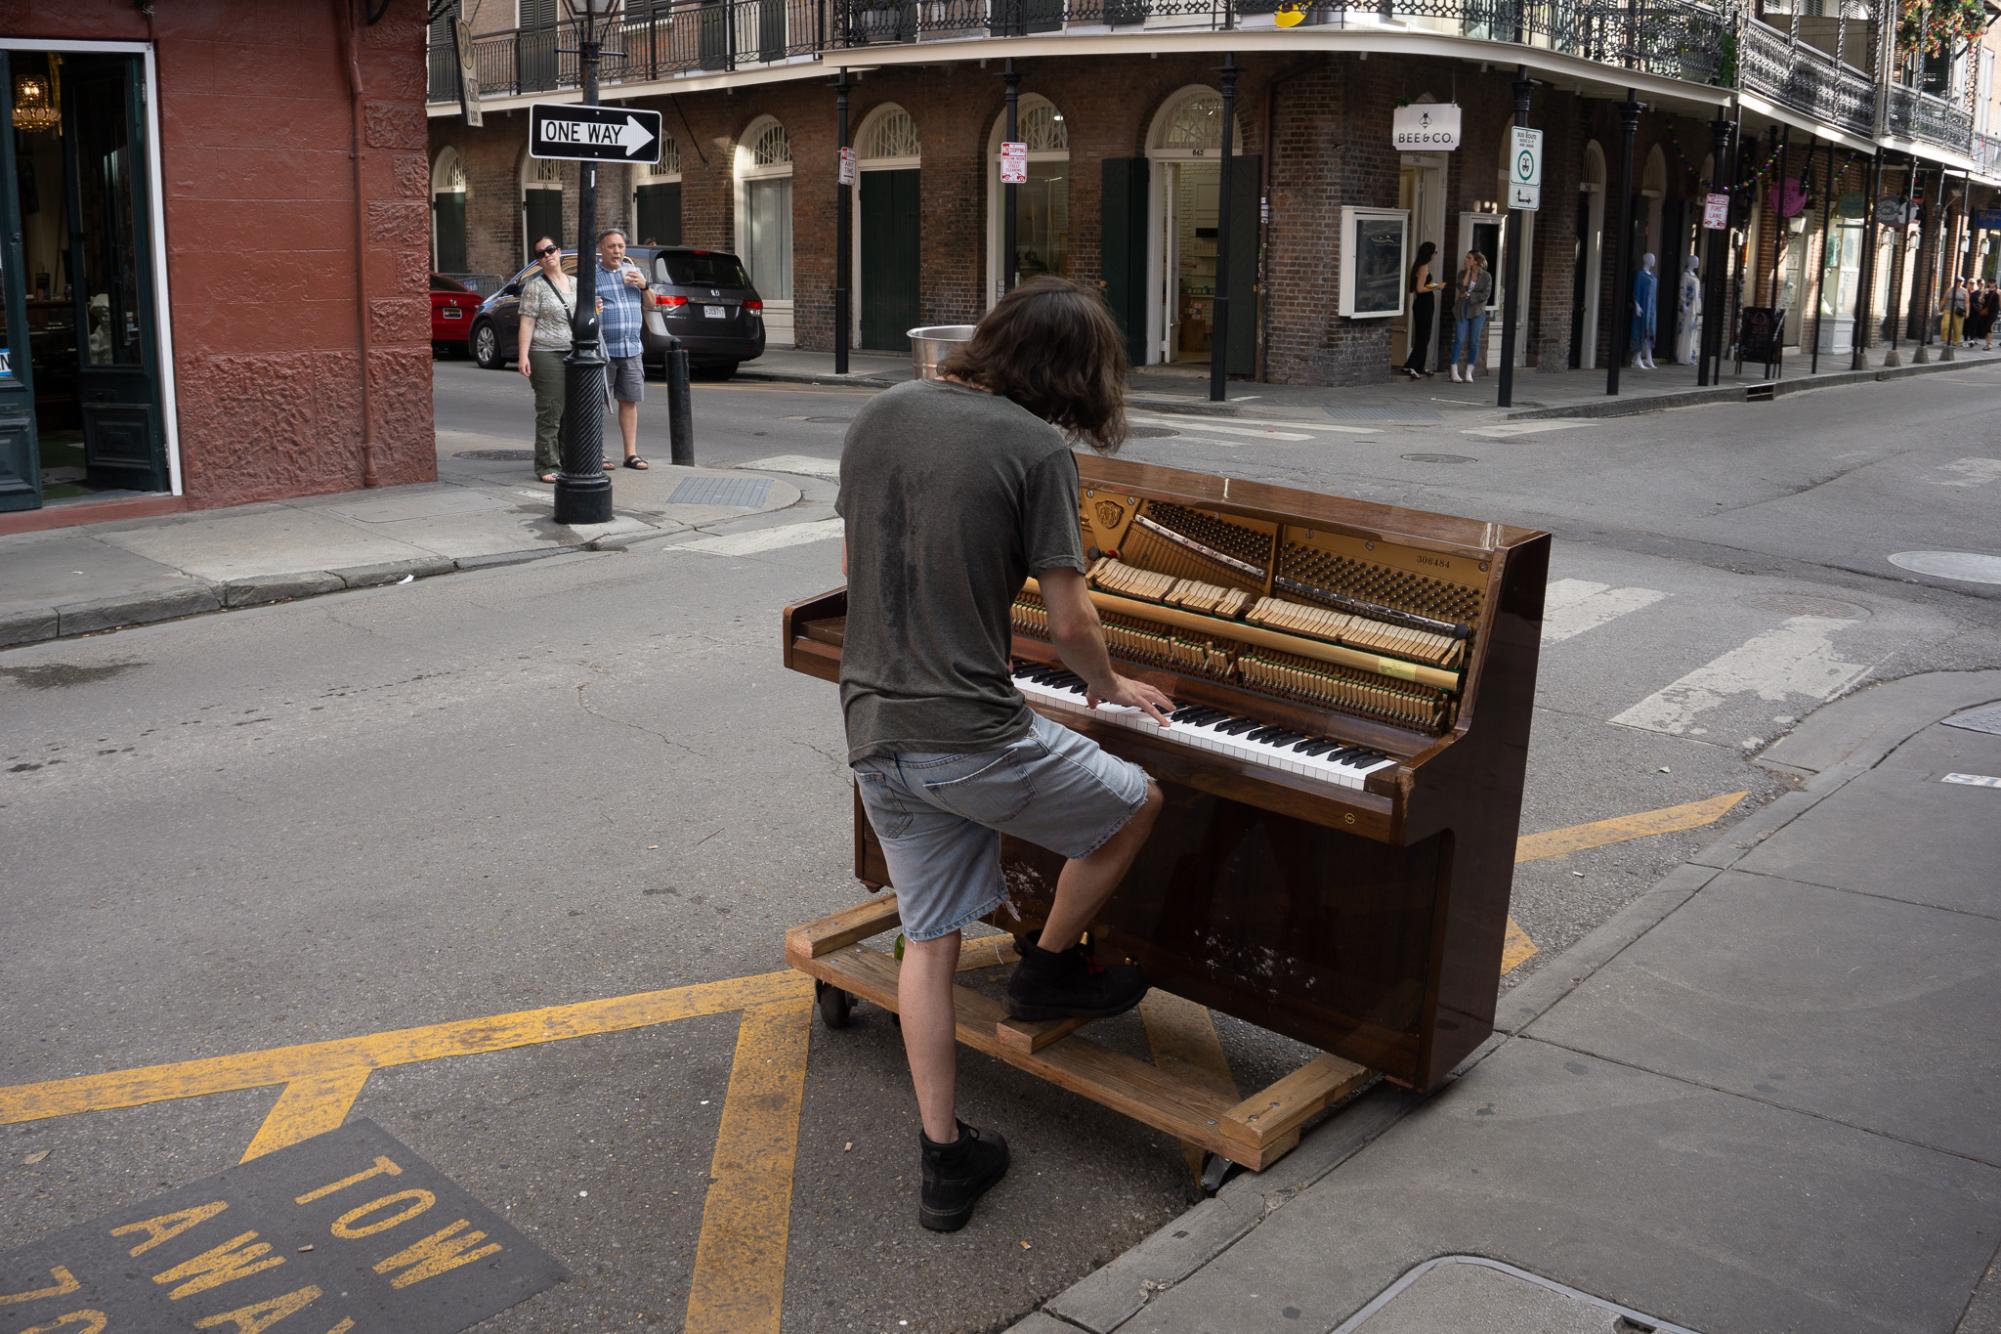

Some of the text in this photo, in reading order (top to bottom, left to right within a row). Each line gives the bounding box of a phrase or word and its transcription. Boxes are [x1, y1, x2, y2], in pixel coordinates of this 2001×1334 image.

[545, 120, 623, 144] ONE WAY
[294, 1155, 503, 1290] TOW
